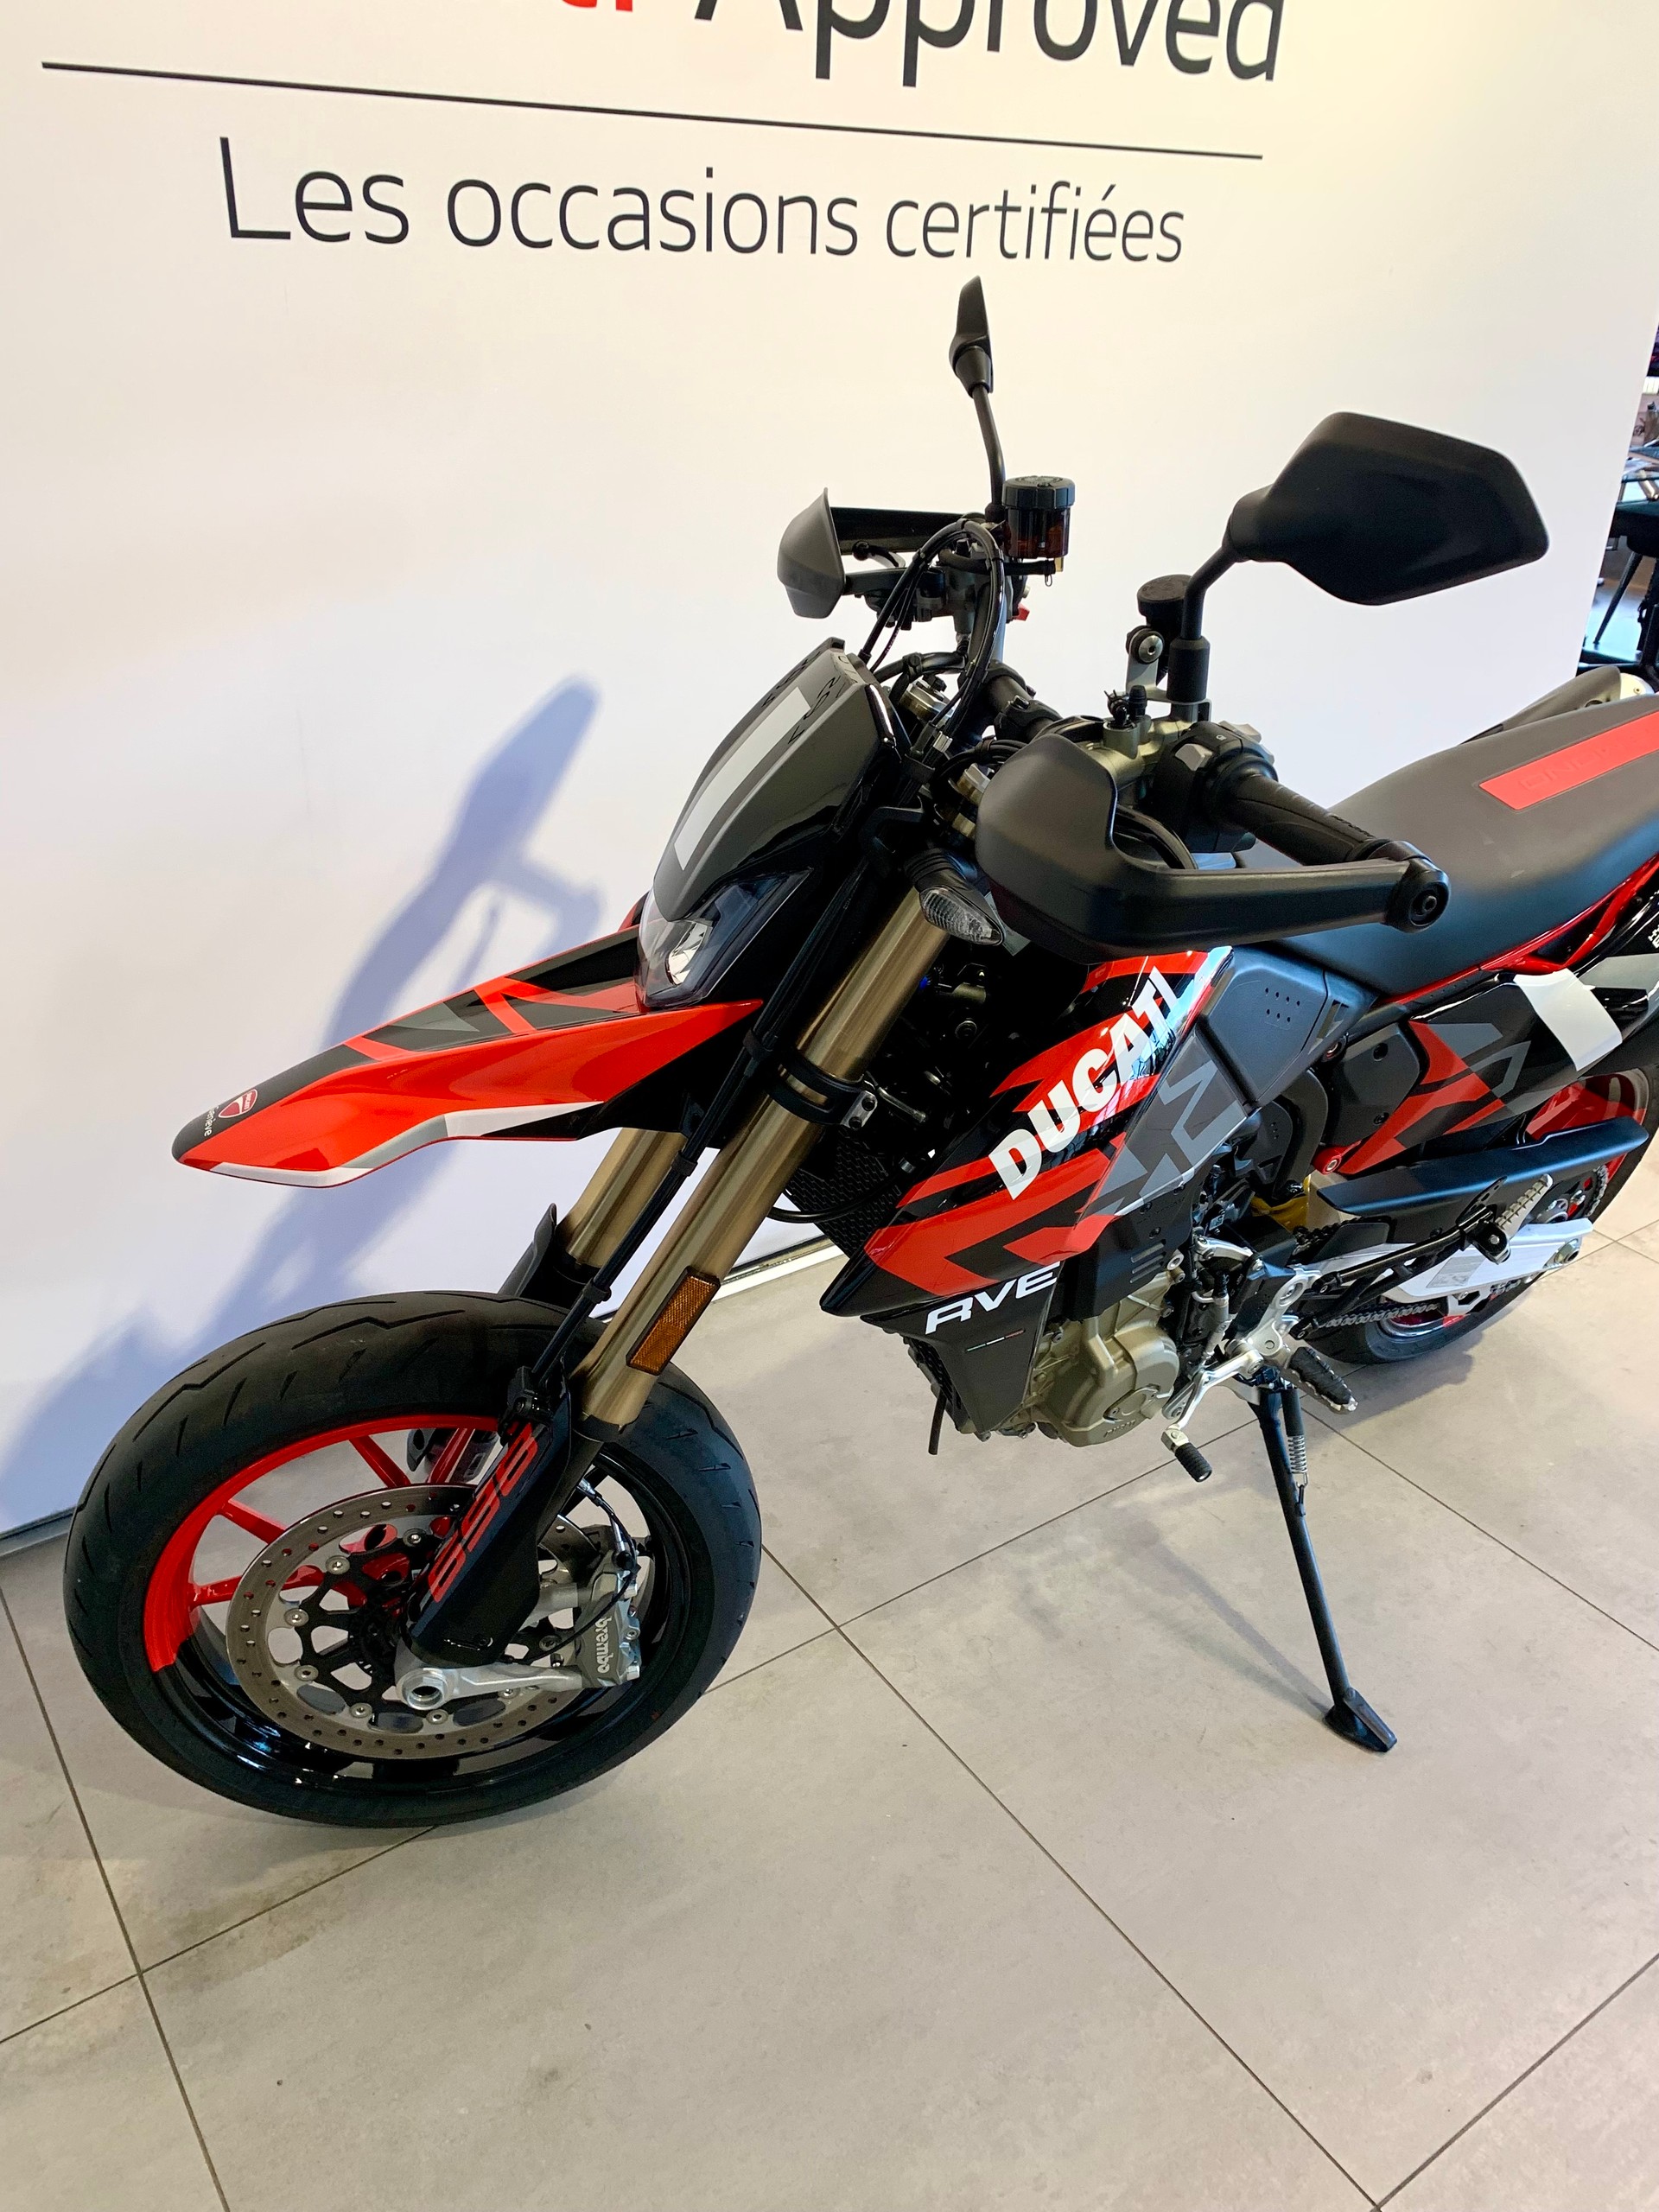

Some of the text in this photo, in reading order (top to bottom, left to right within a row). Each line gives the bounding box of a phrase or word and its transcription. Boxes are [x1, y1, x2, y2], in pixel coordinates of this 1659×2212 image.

[695, 0, 1283, 87] pproved
[220, 137, 1185, 263] Les occasions certifiées
[988, 965, 1180, 1201] DUCATI
[925, 1261, 1061, 1336] RVE
[594, 1616, 614, 1674] brembo
